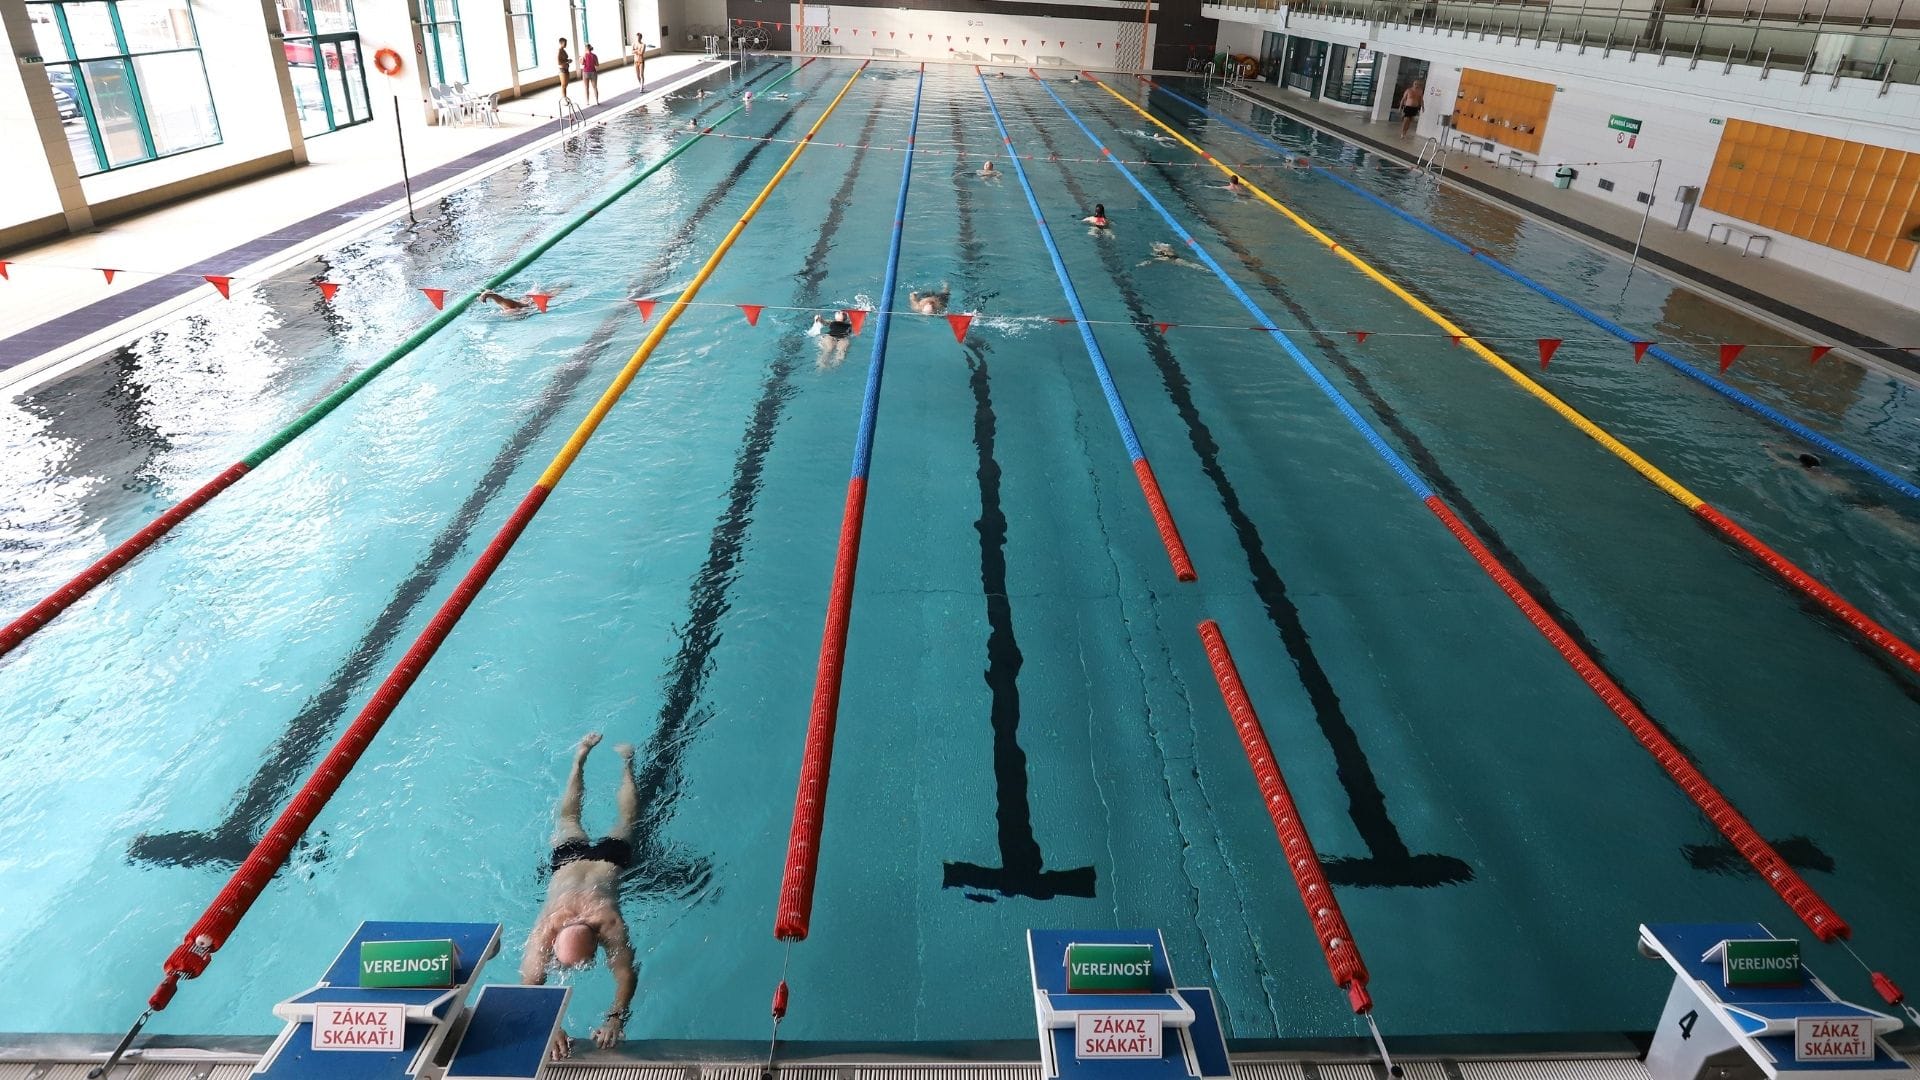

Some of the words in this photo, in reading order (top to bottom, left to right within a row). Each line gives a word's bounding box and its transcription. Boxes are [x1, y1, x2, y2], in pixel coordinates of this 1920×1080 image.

[363, 954, 449, 974] VEREJNOSŤ
[1072, 960, 1152, 976] VEREJNOSŤ
[1729, 954, 1800, 971] VEREJNOSŤ
[332, 1007, 388, 1026] ZÁKAZ
[1093, 1016, 1146, 1034] ZÁKAZ
[1678, 1009, 1699, 1041] 4
[322, 1026, 394, 1046] SKÁKAŤ!
[1811, 1021, 1860, 1038] ZÁKAZ
[1085, 1035, 1153, 1053] SKÁKAŤ!
[1804, 1039, 1866, 1056] SKÁKAŤ!
